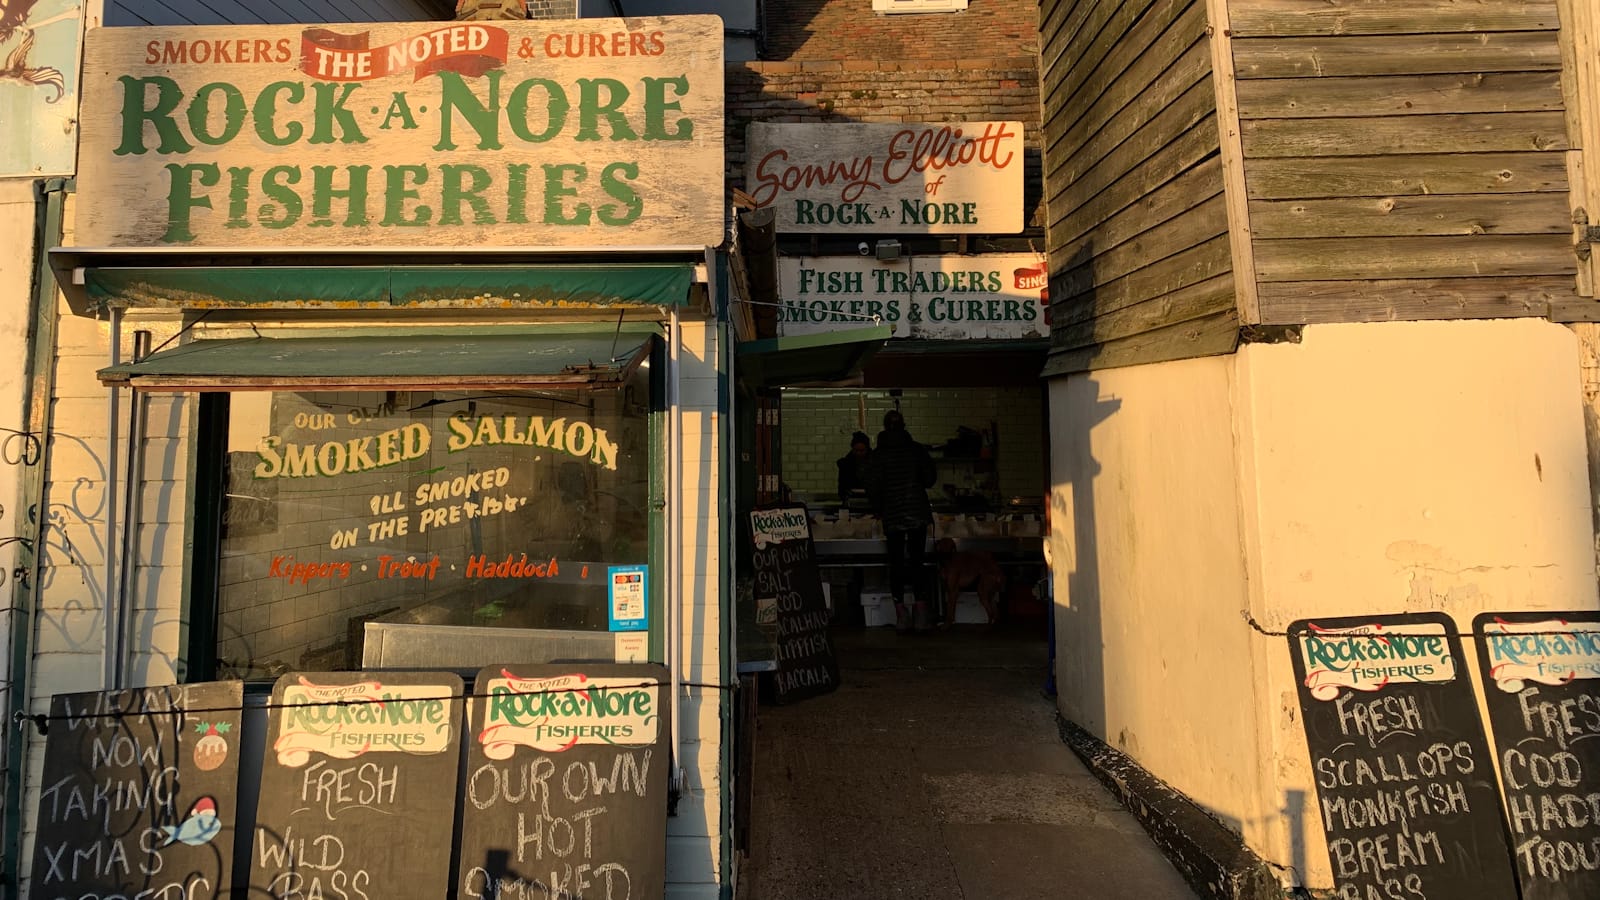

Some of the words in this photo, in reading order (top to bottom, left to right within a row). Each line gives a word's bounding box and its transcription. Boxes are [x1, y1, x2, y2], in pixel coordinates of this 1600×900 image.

[145, 38, 292, 65] SMOKERS
[517, 36, 536, 58] &
[544, 31, 666, 58] CURERS
[315, 47, 373, 78] THE
[387, 26, 490, 72] NOTED
[751, 149, 882, 209] Sonny
[882, 121, 1016, 185] Elliott
[925, 175, 947, 196] of
[160, 161, 643, 243] FISHERIES
[799, 268, 865, 294] FISH
[872, 268, 1003, 294] TRADERS
[908, 303, 924, 322] &
[928, 297, 1038, 322] CURERS
[295, 412, 337, 431] OUR
[253, 422, 433, 479] SMOKED
[447, 410, 619, 472] SALMON
[415, 467, 510, 506] SMOKED
[330, 527, 359, 550] ON
[367, 516, 409, 543] THE
[268, 554, 352, 585] Kippers
[376, 554, 442, 581] Trout
[465, 553, 560, 579] Haddock
[753, 548, 782, 573] OUR
[782, 542, 809, 564] OWN
[758, 569, 793, 593] SALT
[315, 688, 331, 698] THE
[332, 685, 366, 698] NOTED
[1351, 664, 1435, 684] FISHERIES
[65, 689, 127, 731] WE
[138, 685, 200, 742] ARE
[536, 724, 633, 742] FISHERIES
[1335, 691, 1424, 748] FRESH
[1518, 687, 1600, 751] FRES
[92, 729, 164, 774] NOW
[330, 732, 426, 749] FISHERIES
[469, 756, 556, 823] OUR
[562, 749, 653, 803] OWN
[1318, 741, 1476, 789] SCALLOPS
[1504, 748, 1582, 790] COD
[40, 766, 181, 837] TAKING
[302, 760, 399, 821] FRESH
[1322, 780, 1471, 838] MONKFISH
[43, 827, 164, 886] XMAS
[258, 826, 345, 871] WILD
[517, 806, 608, 863] HOT
[1329, 830, 1446, 886] BREAM
